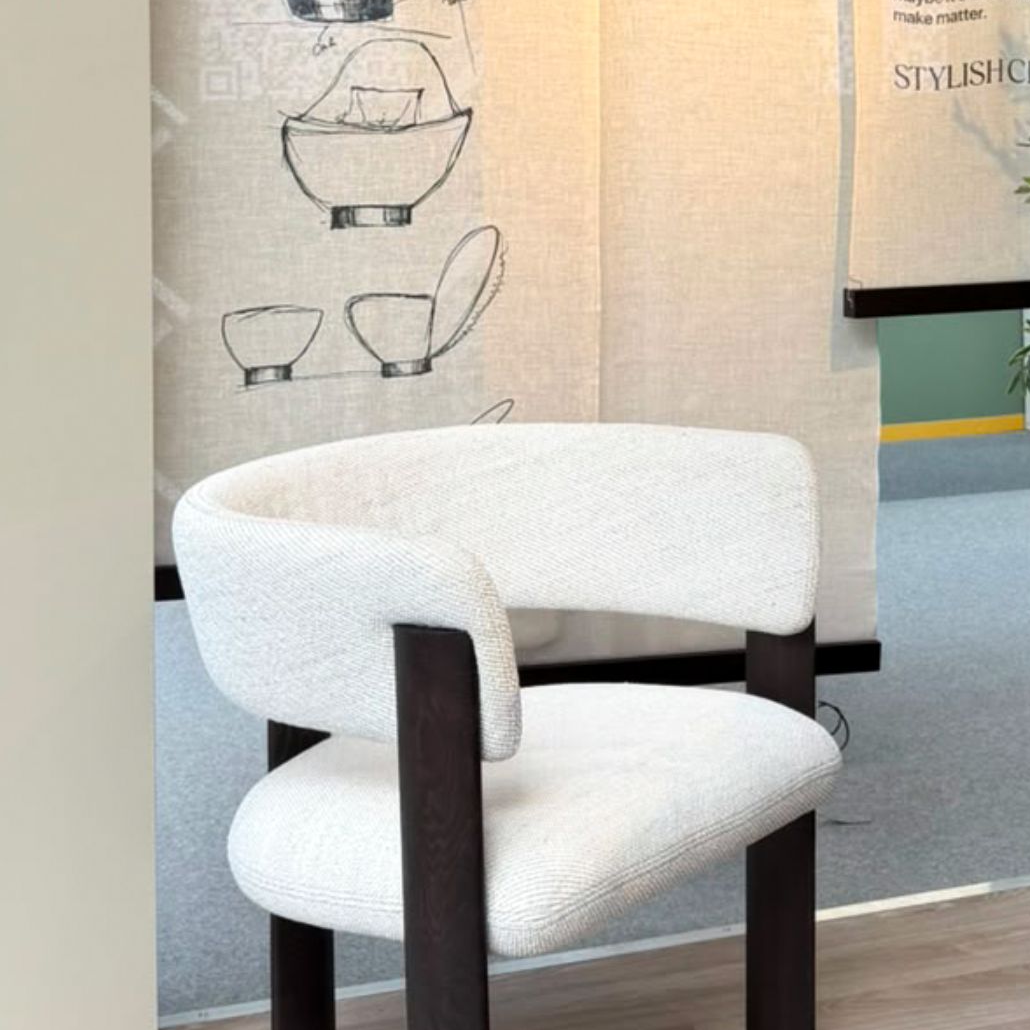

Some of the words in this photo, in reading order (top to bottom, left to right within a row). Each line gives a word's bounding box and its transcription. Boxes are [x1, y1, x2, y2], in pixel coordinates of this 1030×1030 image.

[893, 9, 933, 25] make
[937, 8, 988, 25] matter.
[894, 58, 1004, 91] STYLISH
